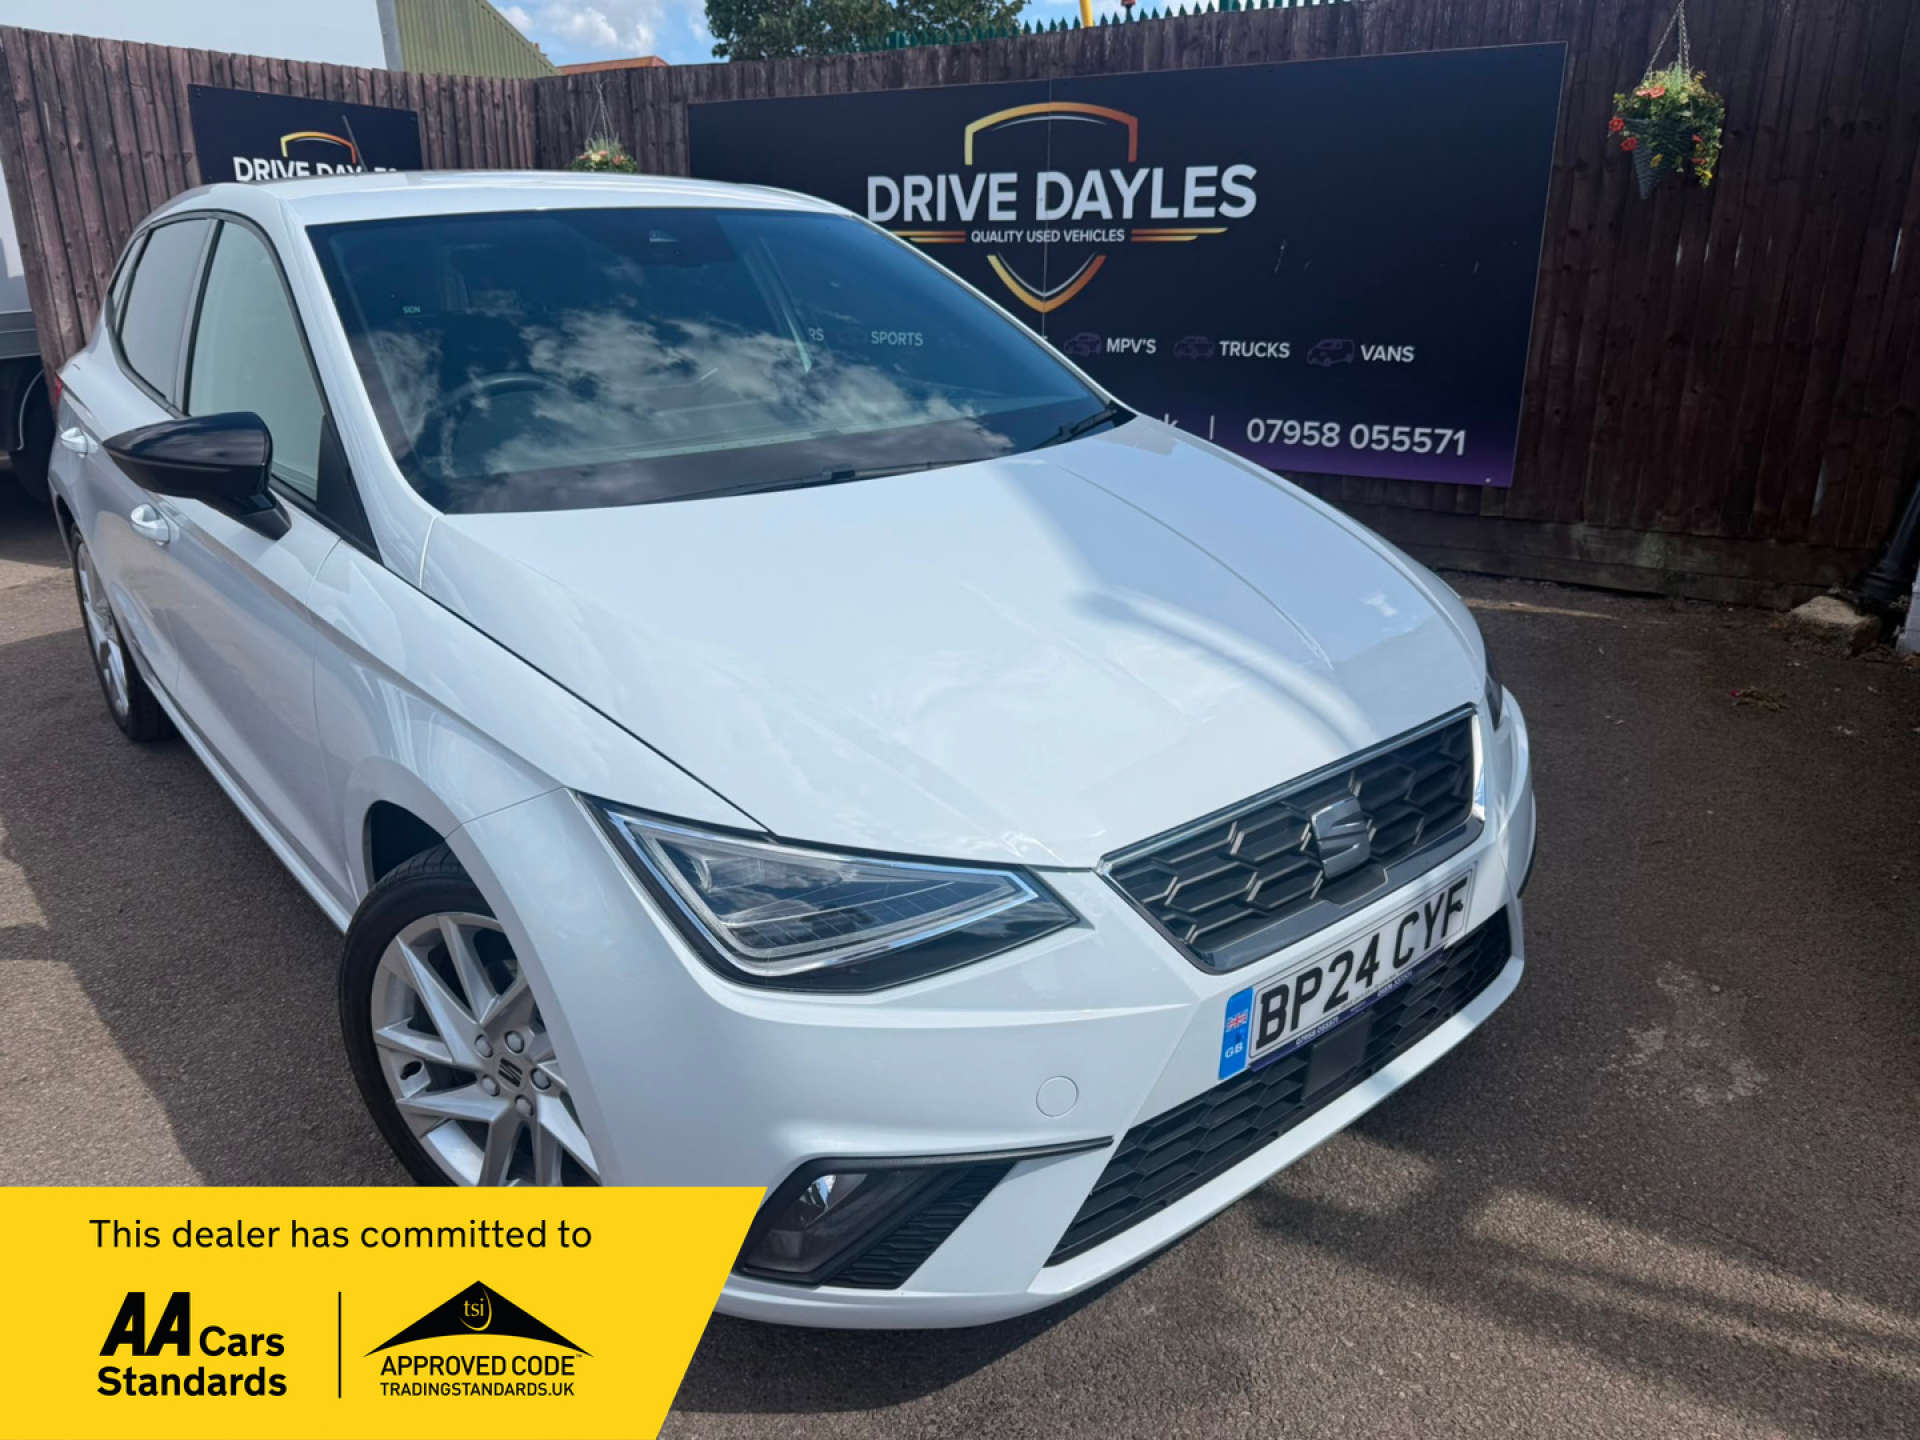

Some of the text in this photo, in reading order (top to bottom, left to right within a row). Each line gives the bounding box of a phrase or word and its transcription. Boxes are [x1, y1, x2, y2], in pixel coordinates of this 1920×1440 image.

[232, 156, 311, 182] DRIVE
[867, 164, 1258, 222] DRIVE DAYLES
[971, 229, 1125, 243] QUALITY USED VEHICLES
[871, 331, 924, 347] SPORTS
[1106, 337, 1157, 355] MPV'S
[1218, 340, 1291, 359] TRUCKS
[1360, 344, 1415, 363] VANS
[1245, 418, 1467, 456] 07958 055571
[1255, 876, 1469, 1051] BP24 CYF
[1224, 1042, 1244, 1058] GB
